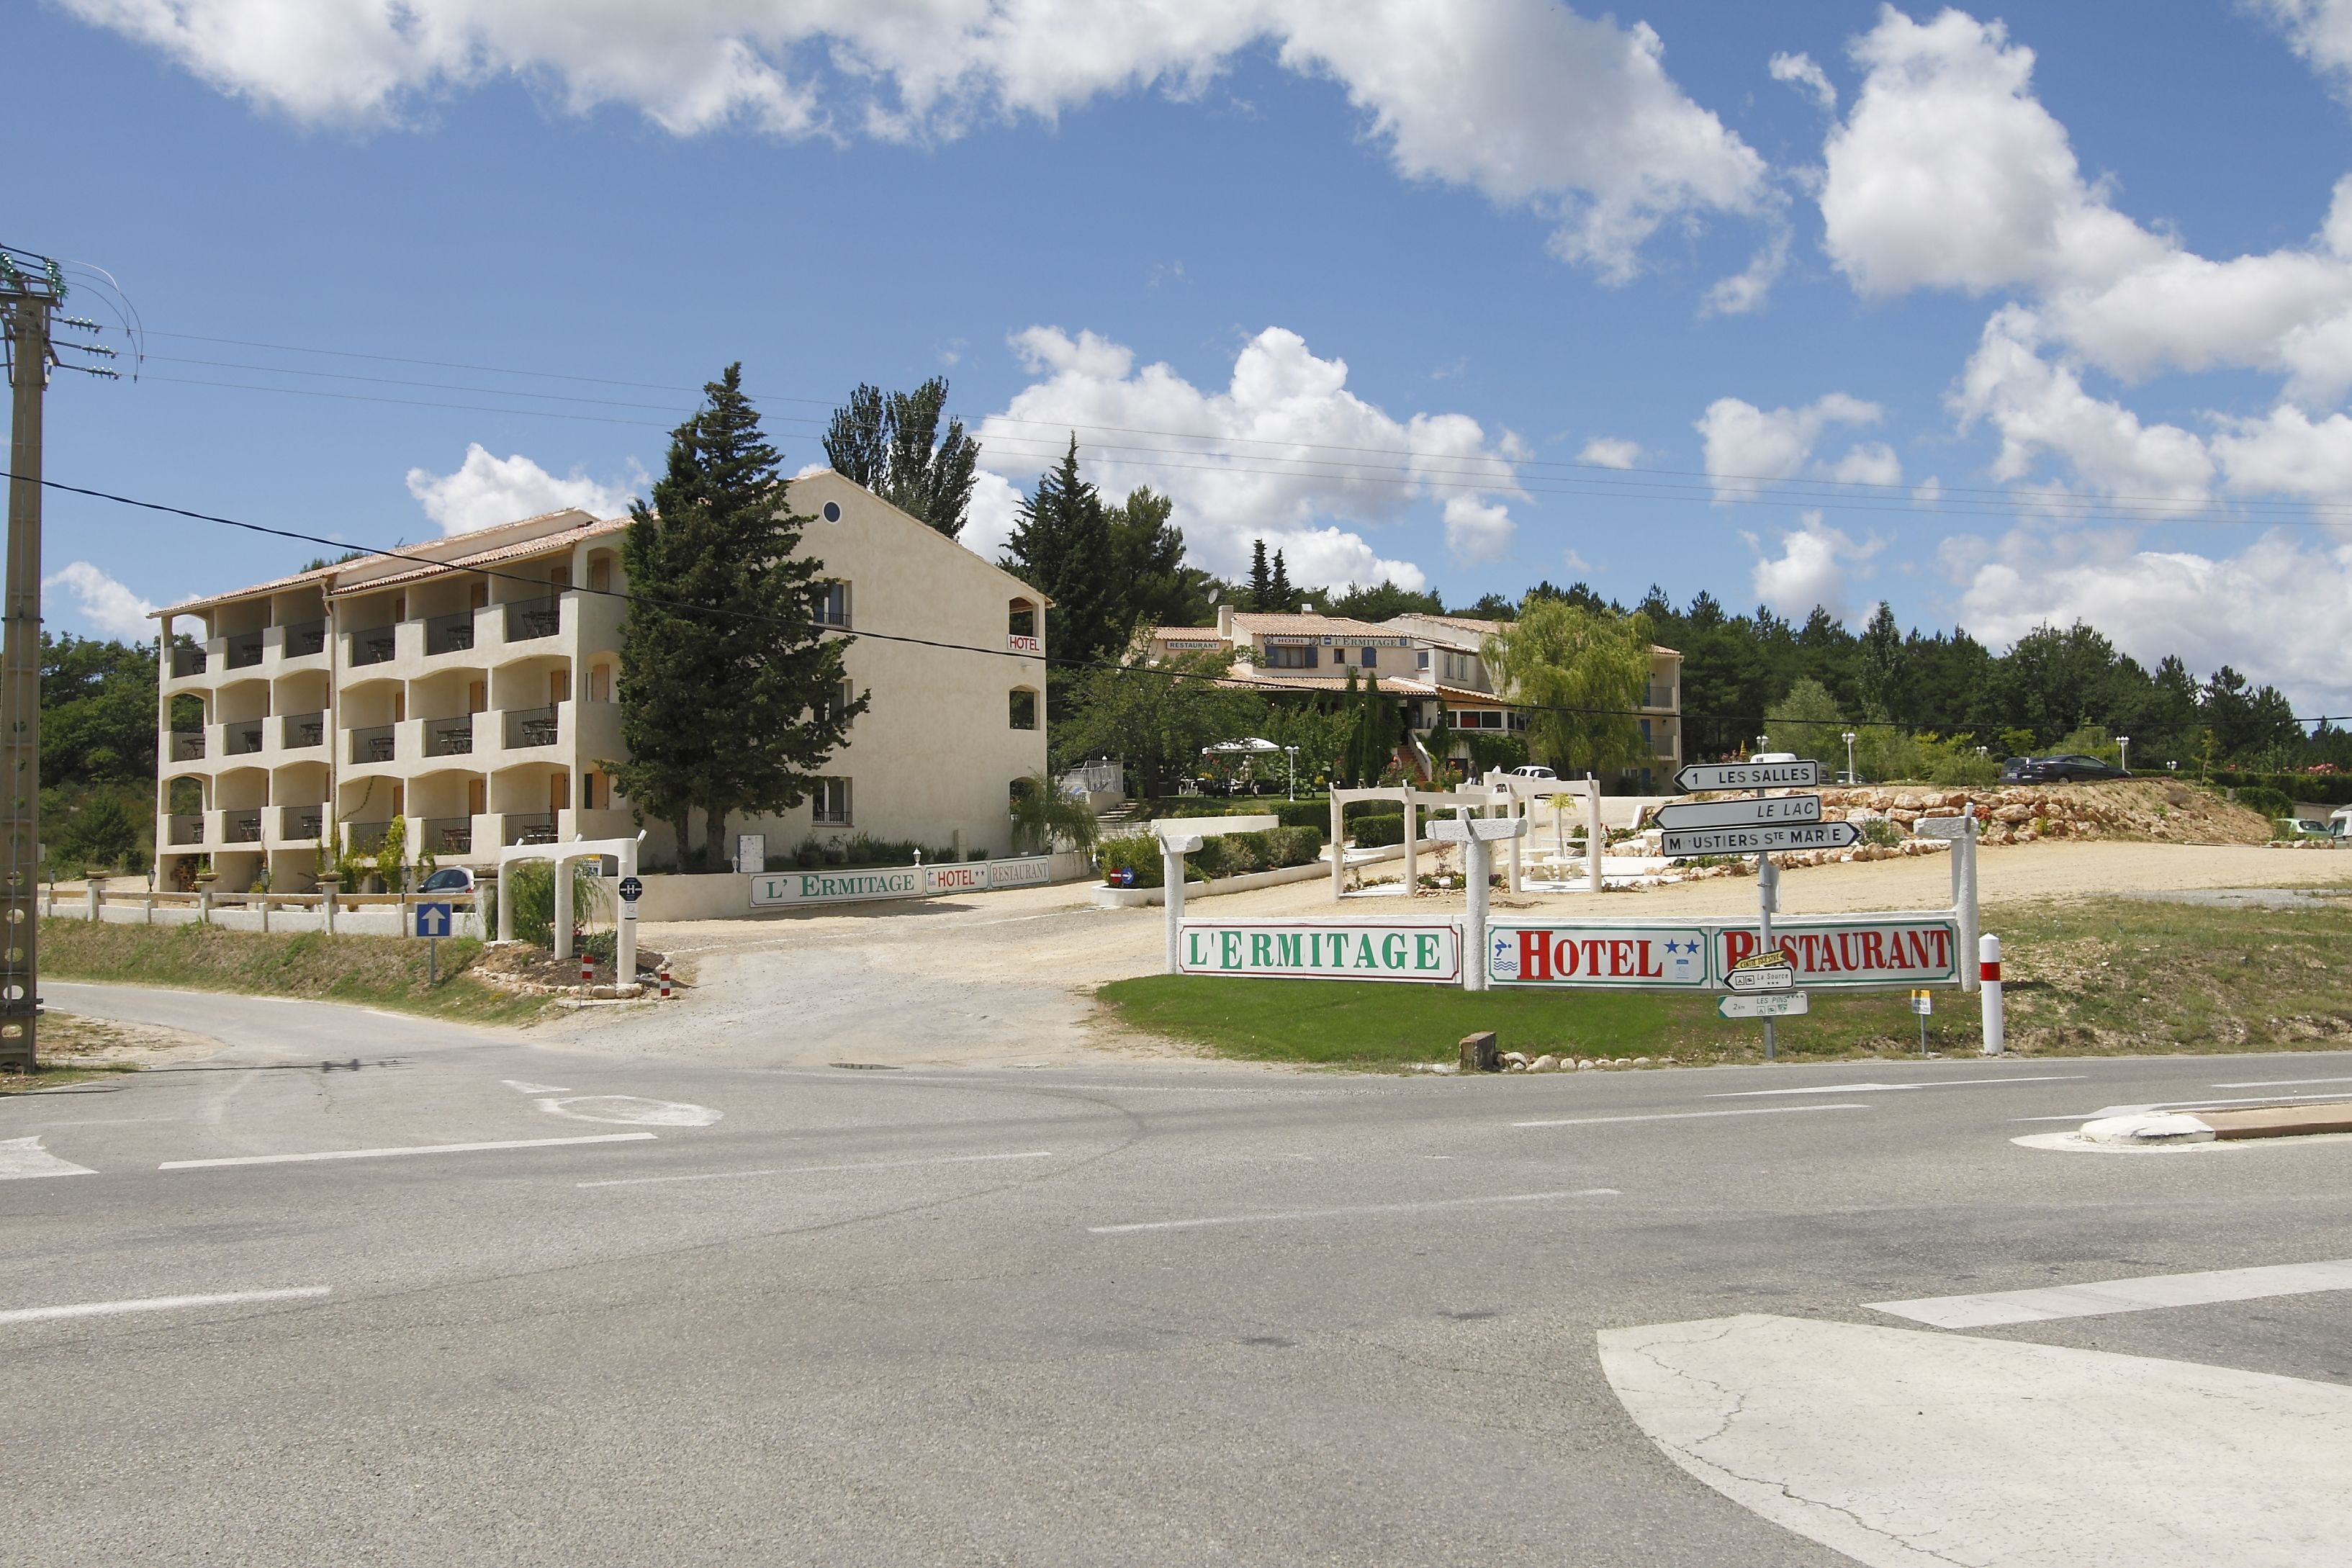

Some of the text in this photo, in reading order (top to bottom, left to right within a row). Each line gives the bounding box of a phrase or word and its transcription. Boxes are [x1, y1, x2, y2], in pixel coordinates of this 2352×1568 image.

[1010, 636, 1040, 651] HOTEL
[1693, 768, 1810, 785] 1 LES SALLES
[1757, 802, 1813, 818] LE LAC
[1670, 834, 1759, 850] MUSTIERS
[937, 870, 975, 888] HOTEL
[992, 862, 1048, 883] RESTAURANT
[1516, 930, 1663, 981] HOTEL
